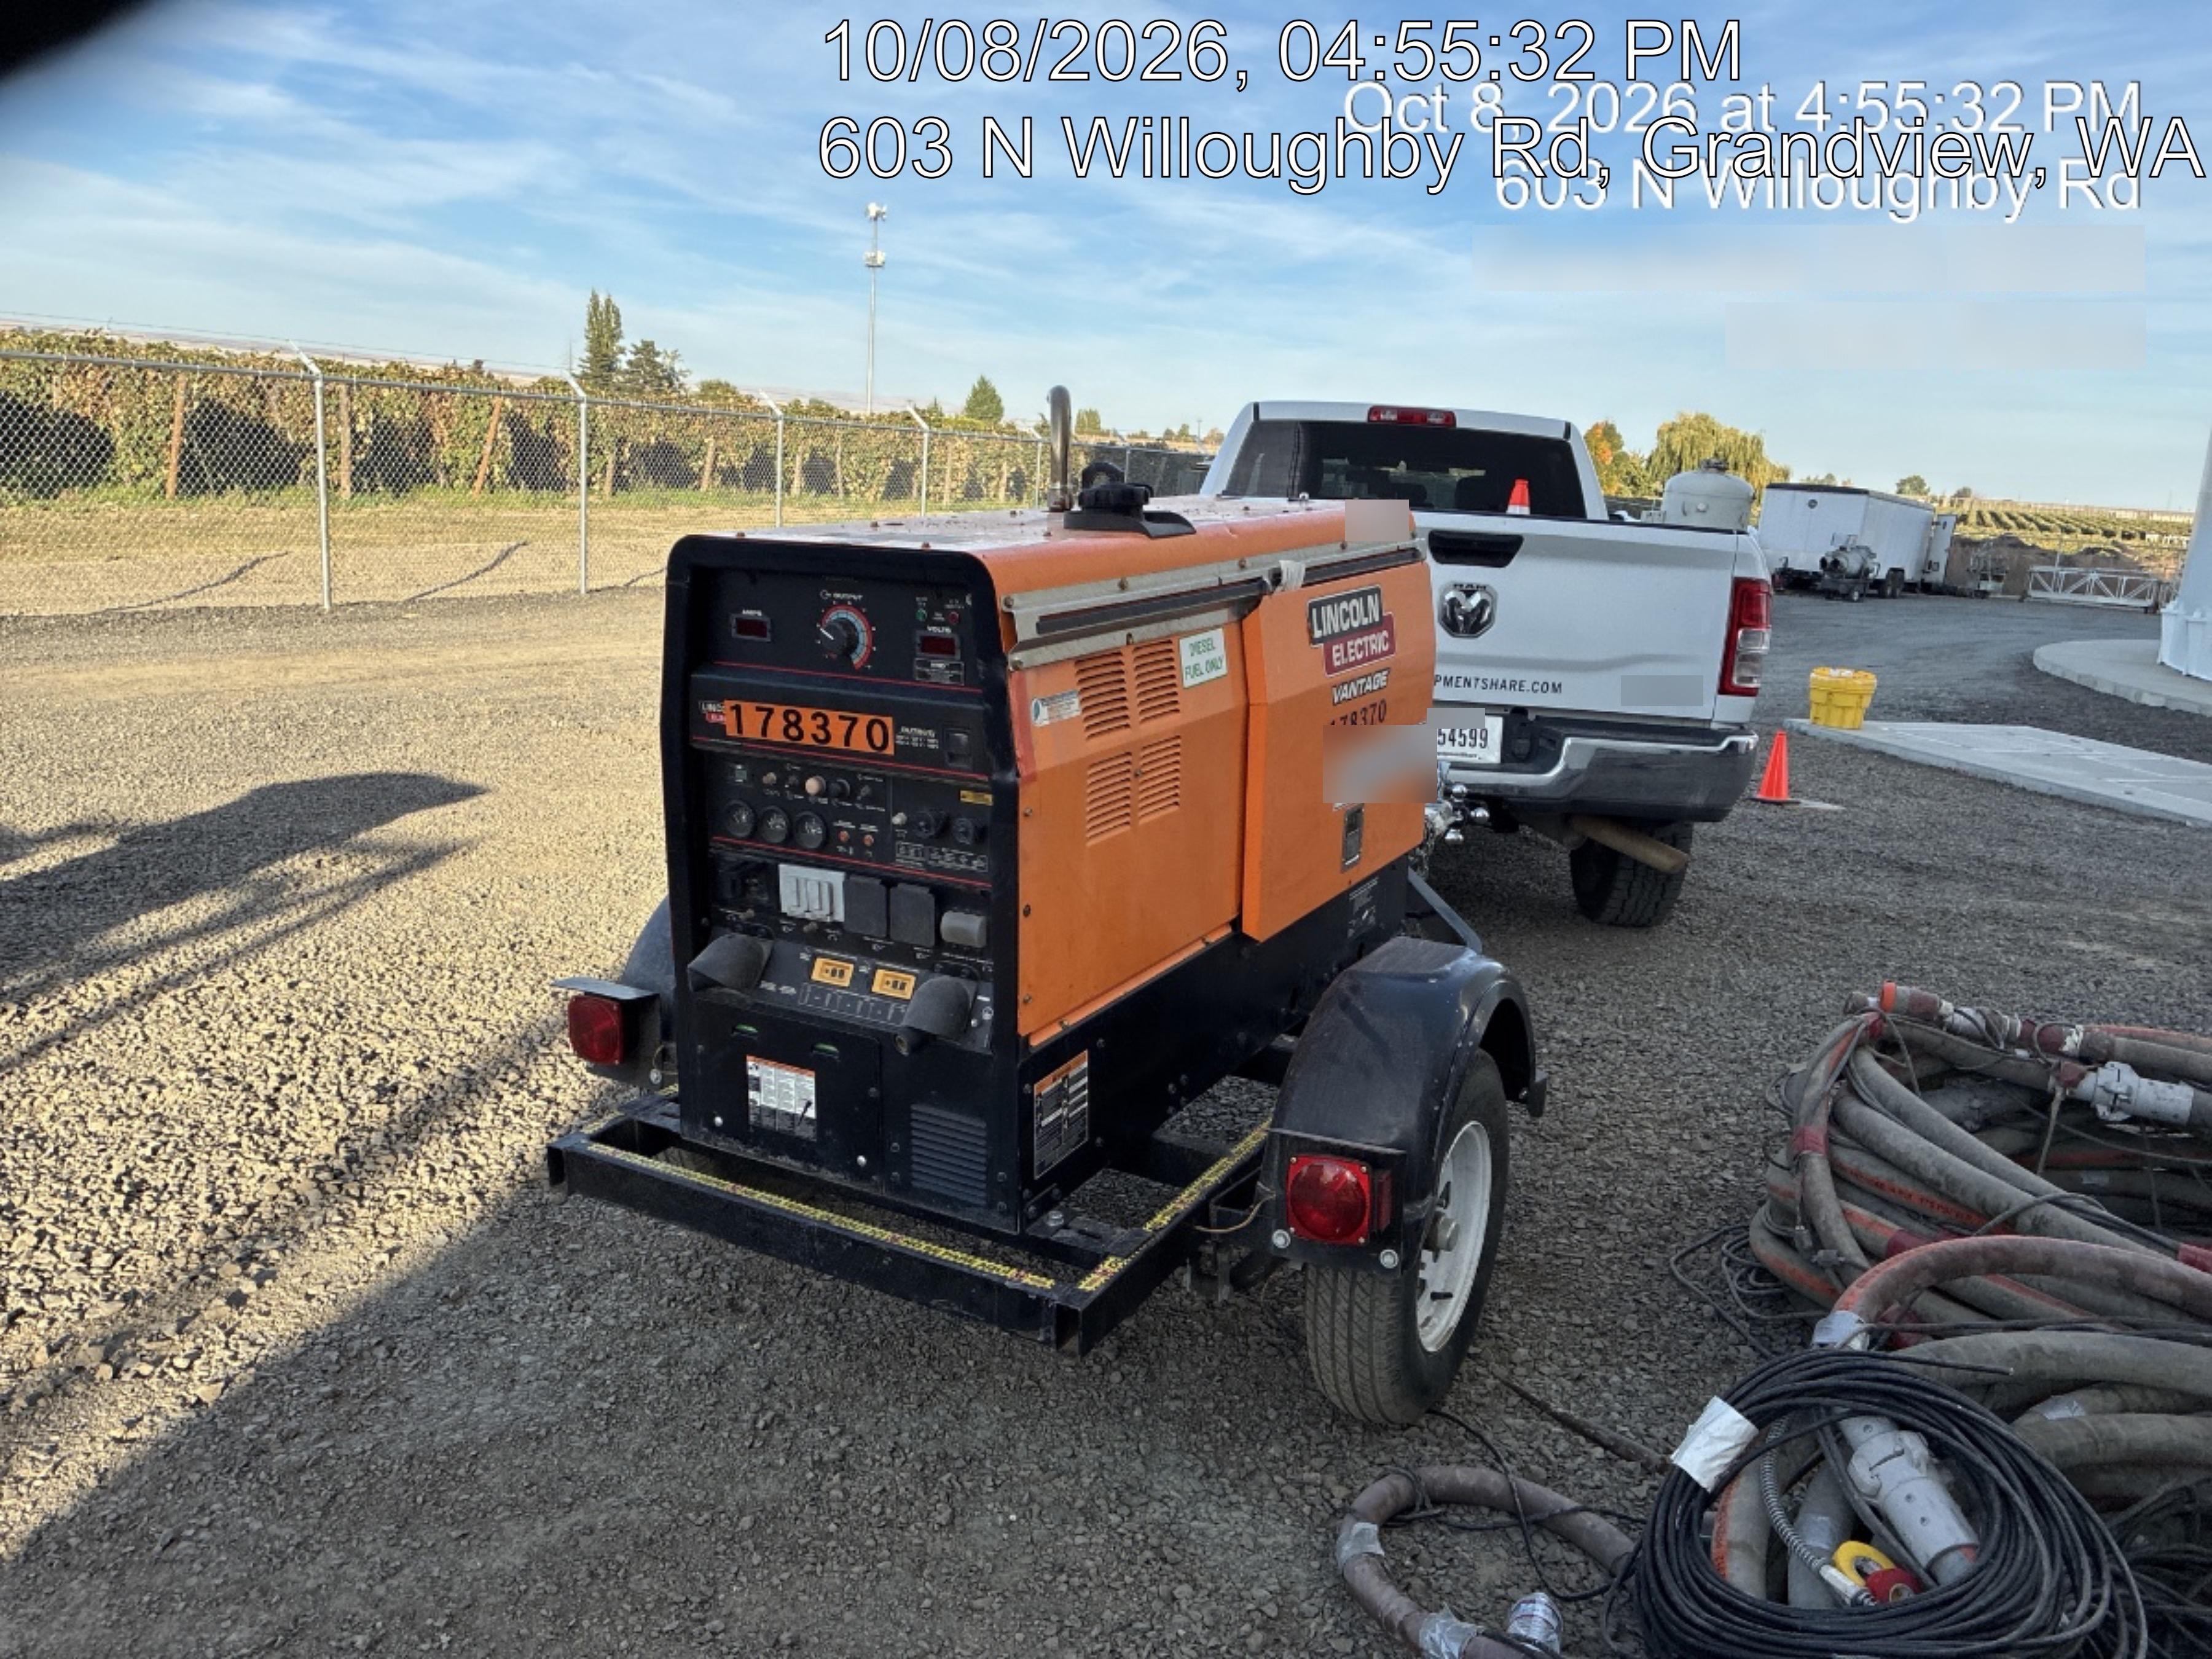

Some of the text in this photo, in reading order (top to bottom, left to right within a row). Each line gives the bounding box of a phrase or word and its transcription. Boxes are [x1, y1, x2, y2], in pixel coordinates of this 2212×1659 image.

[1312, 593, 1380, 639] LINCOLN
[1189, 637, 1216, 657] DIESEL
[1332, 629, 1389, 667] ELECTRIC
[1184, 656, 1223, 681] FUEL ONLY
[1332, 667, 1390, 707] VANTAGE
[729, 703, 889, 752] 178370
[1330, 697, 1387, 725] 78370
